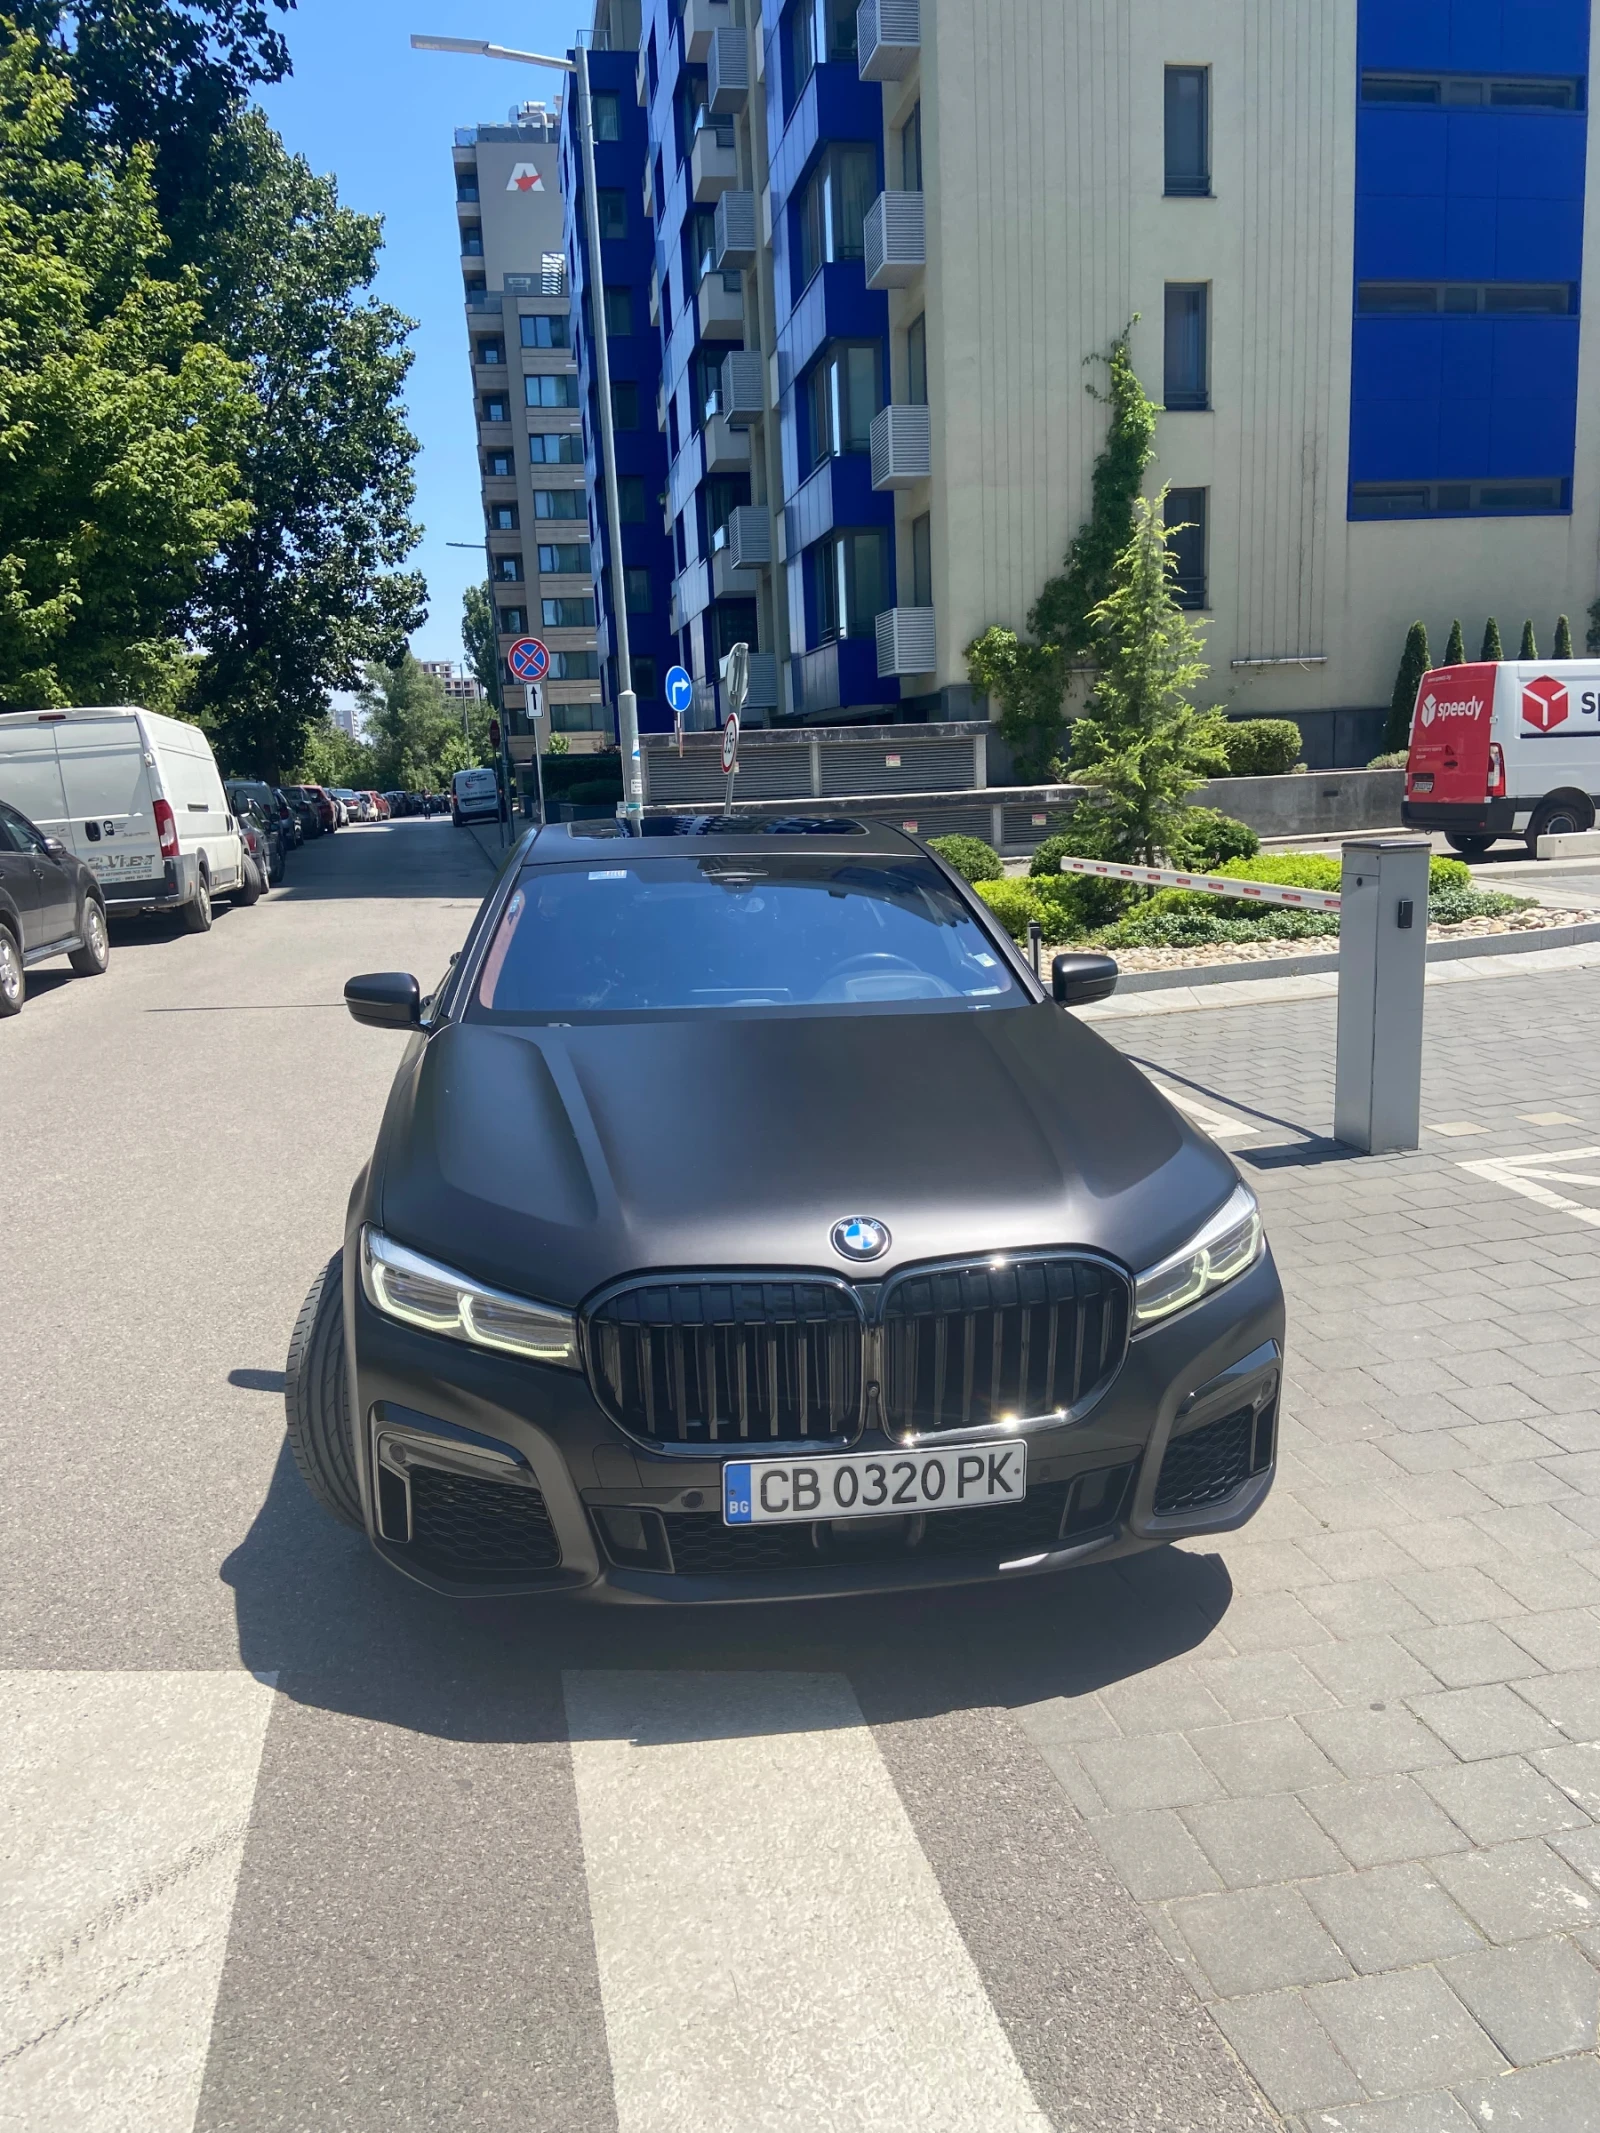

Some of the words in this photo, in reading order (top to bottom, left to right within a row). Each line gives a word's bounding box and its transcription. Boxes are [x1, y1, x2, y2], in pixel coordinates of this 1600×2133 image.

[1437, 695, 1484, 722] speedy
[1581, 691, 1600, 722] s
[838, 1218, 880, 1231] BMW
[760, 1468, 821, 1513] CB
[833, 1459, 946, 1508] 0320
[957, 1451, 1013, 1499] PK
[729, 1500, 749, 1514] BG
